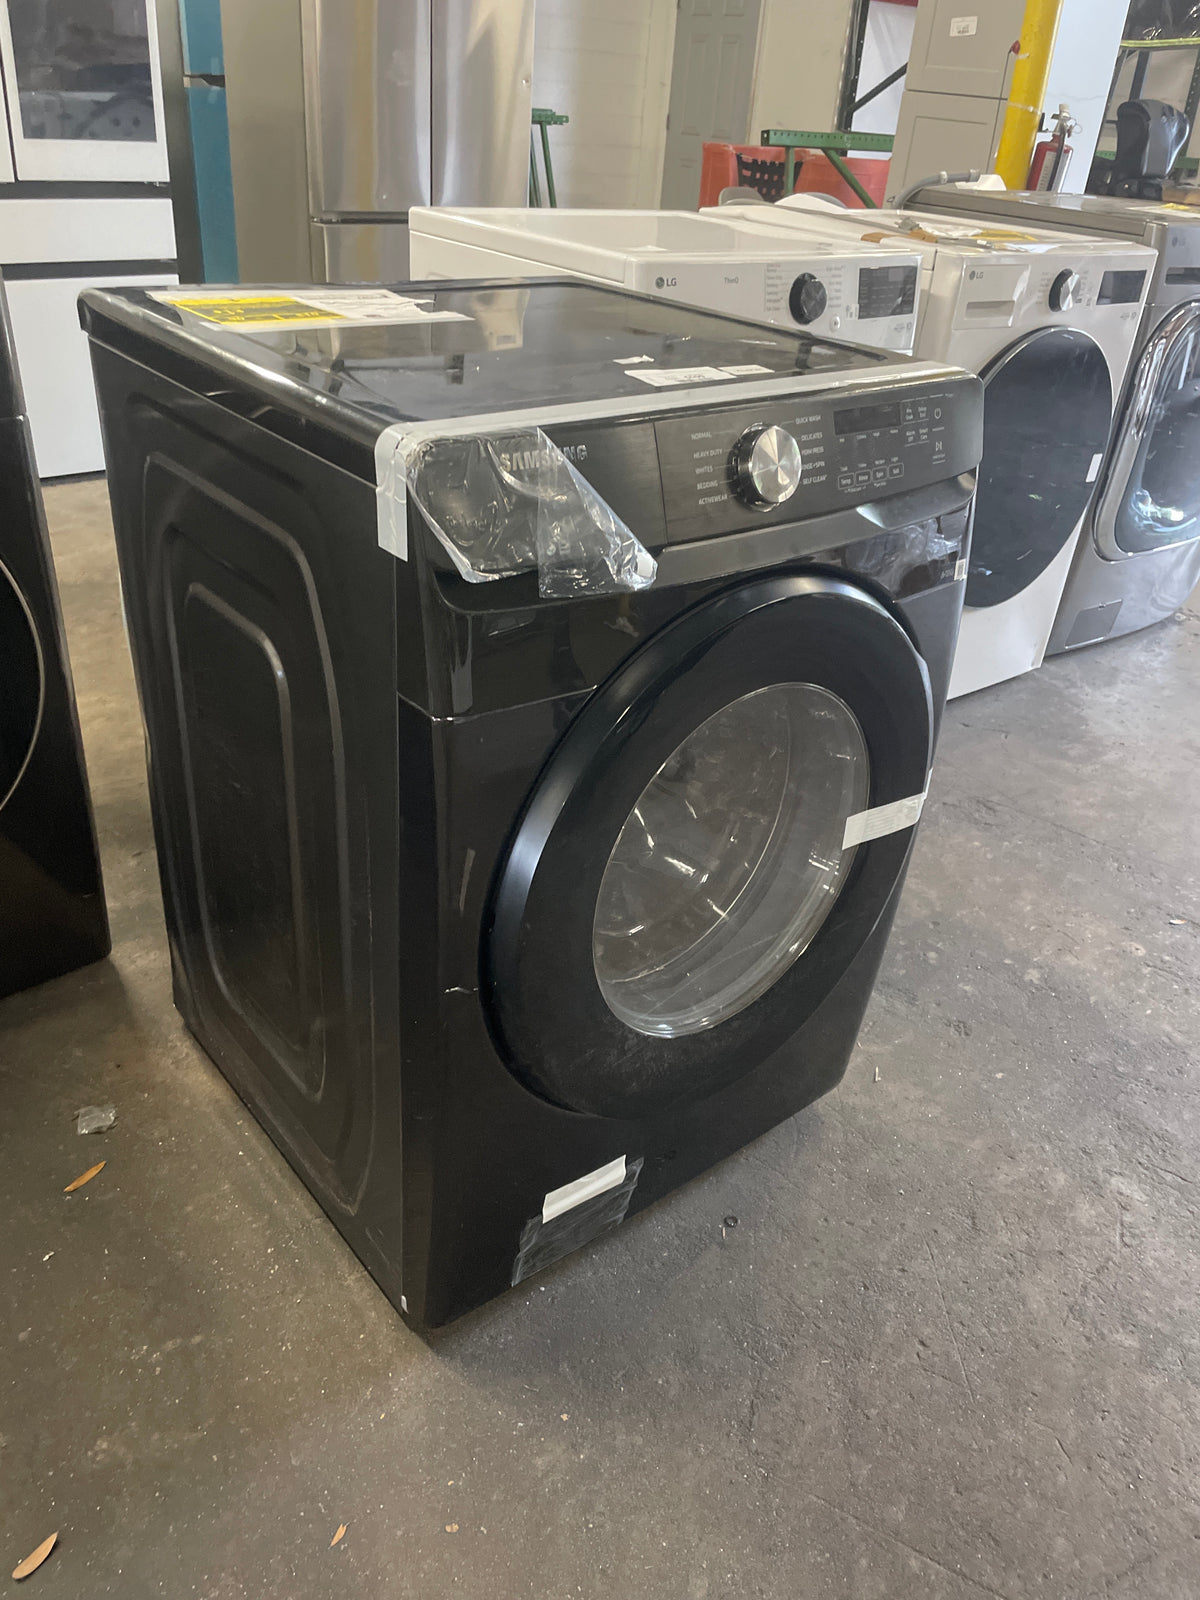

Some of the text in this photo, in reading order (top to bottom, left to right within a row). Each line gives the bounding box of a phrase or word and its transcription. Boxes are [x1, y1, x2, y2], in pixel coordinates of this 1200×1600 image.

[795, 416, 808, 424] QUICK
[691, 432, 712, 440] NORMAL
[801, 432, 823, 441] DELICATES
[500, 444, 588, 472] SAMSUNG
[693, 448, 723, 459] HEAVY DUTY
[695, 465, 714, 474] WHITES
[697, 480, 719, 490] BEDDING
[699, 494, 728, 505] ACTIVEWEAR
